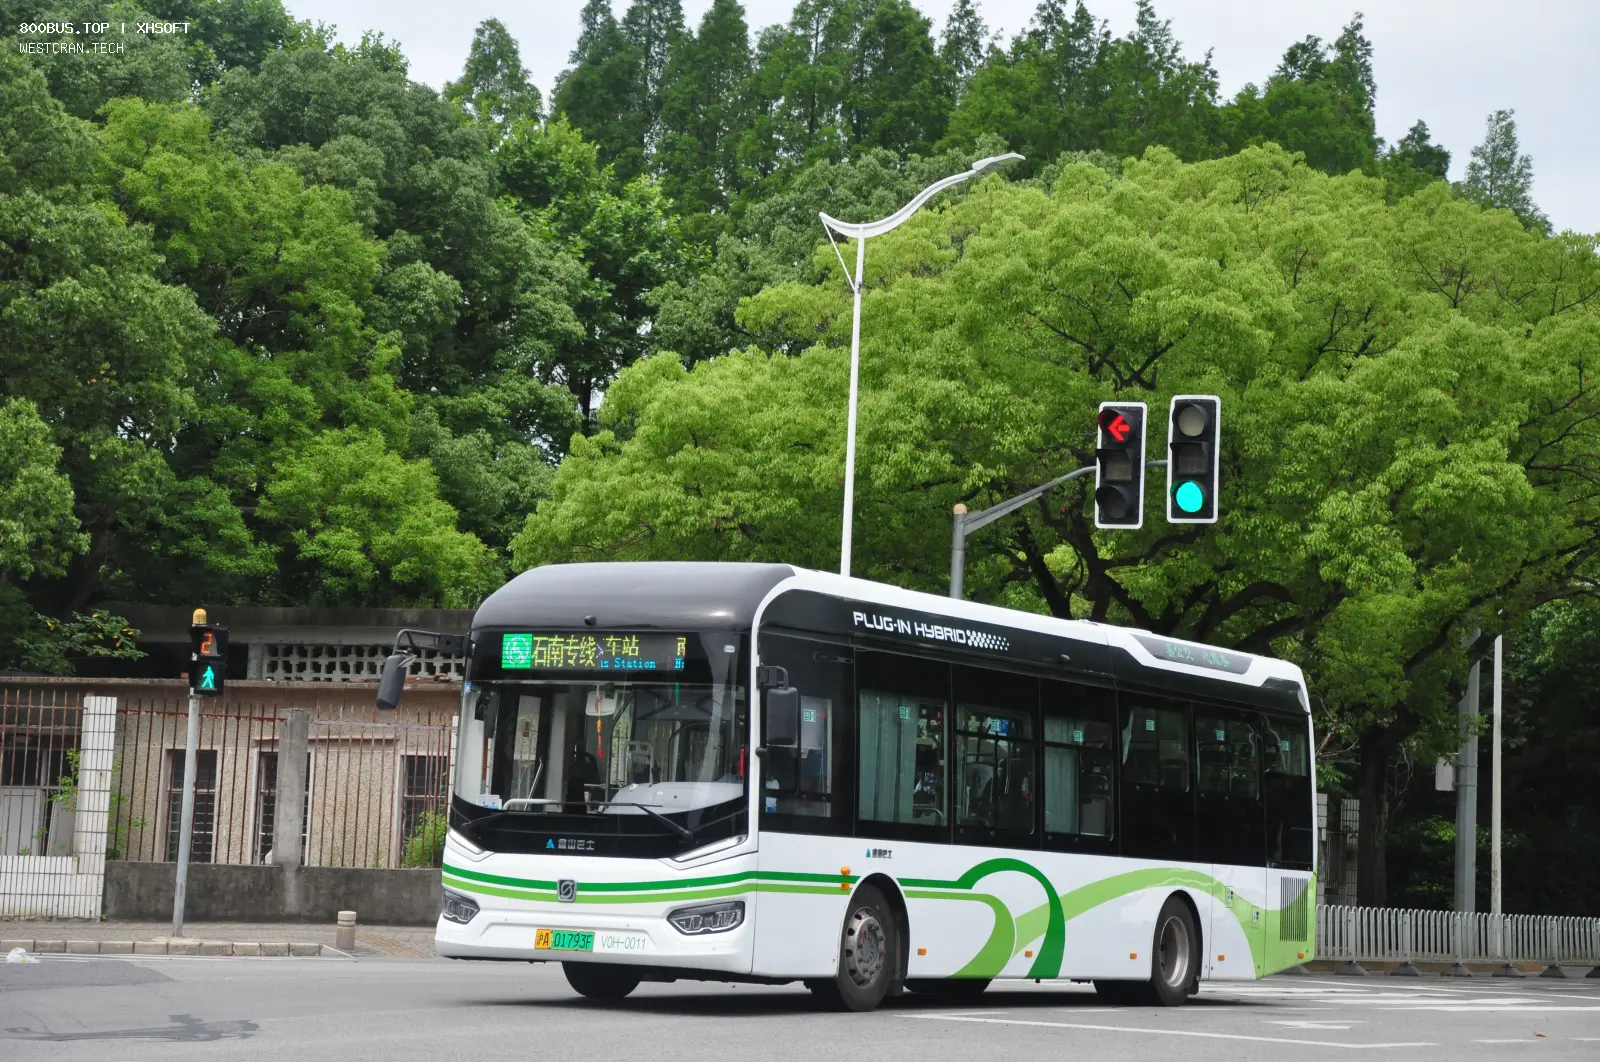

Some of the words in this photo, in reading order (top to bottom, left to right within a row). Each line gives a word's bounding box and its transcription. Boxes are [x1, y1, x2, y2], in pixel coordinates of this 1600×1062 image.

[853, 611, 912, 635] PLUG-IN
[914, 621, 967, 644] HYBRID
[201, 632, 213, 654] 2
[531, 634, 596, 668] 石南专线
[614, 657, 656, 669] Station
